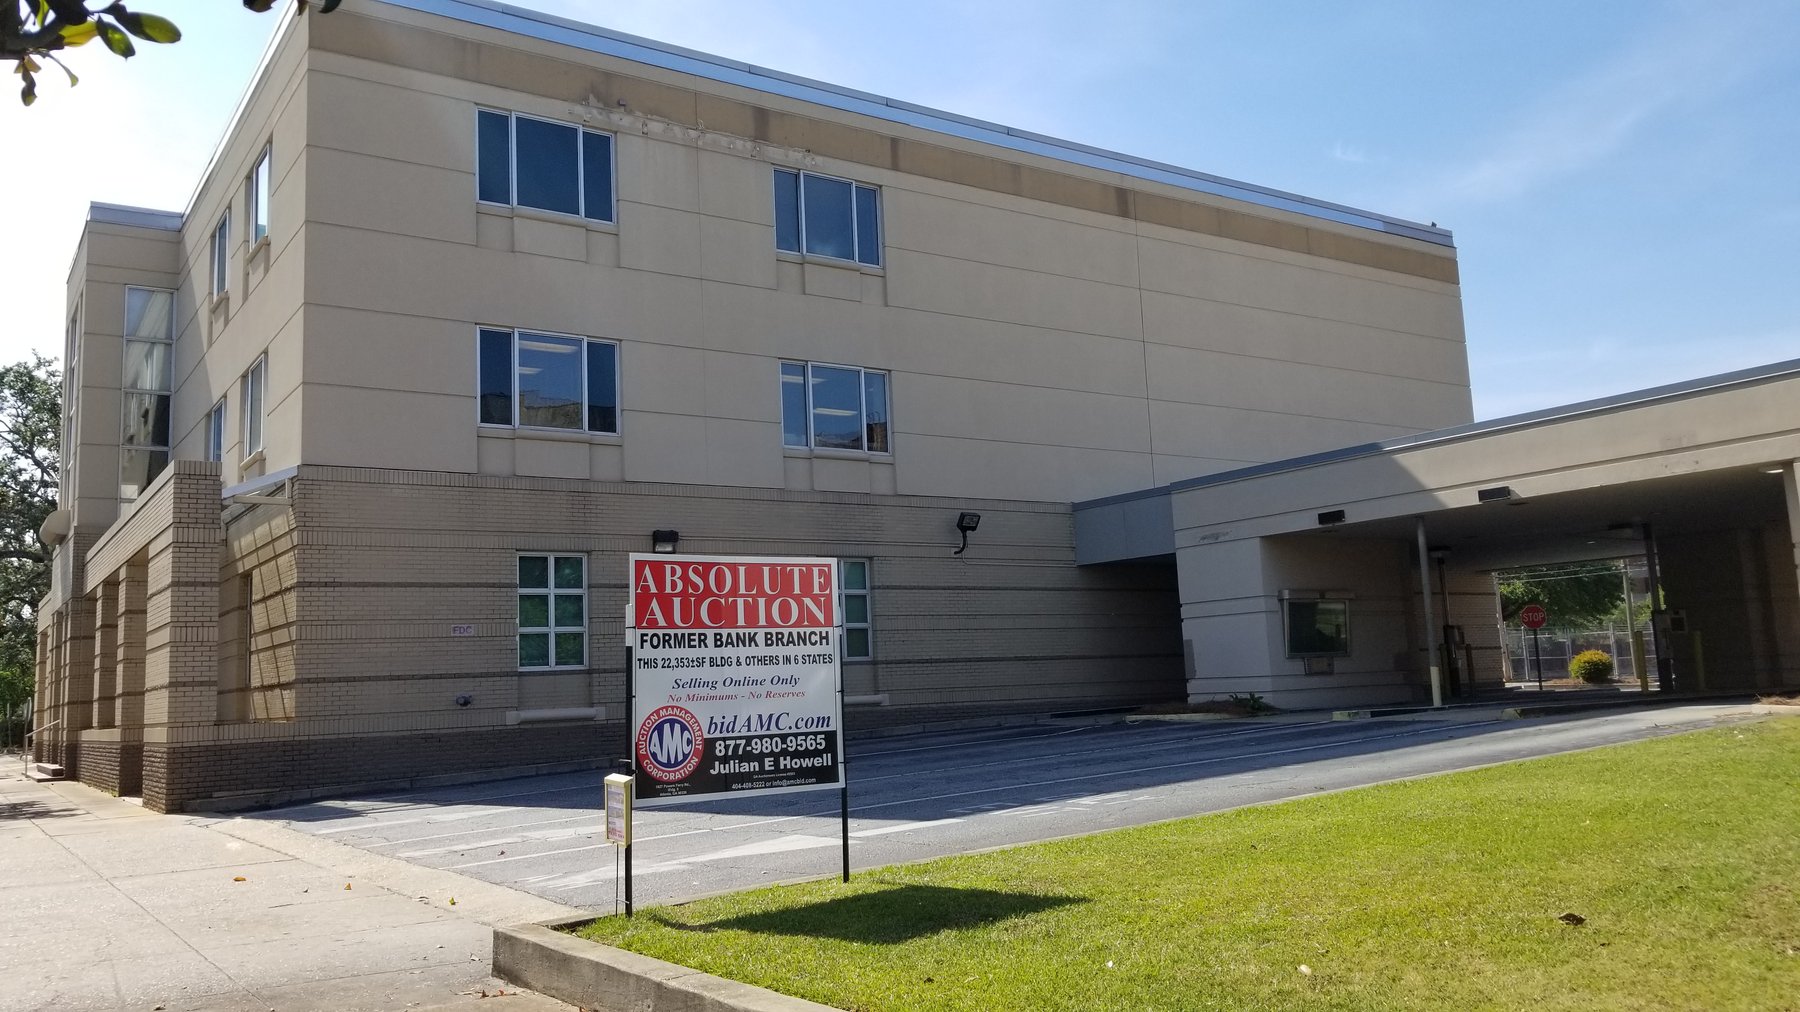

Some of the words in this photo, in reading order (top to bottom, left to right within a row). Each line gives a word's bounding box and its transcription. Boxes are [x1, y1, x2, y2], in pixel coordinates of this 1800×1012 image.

[636, 563, 831, 595] ABSOLUTE
[642, 596, 827, 627] AUCTION
[1523, 612, 1544, 622] STOP
[639, 632, 709, 650] FORMER
[713, 631, 759, 648] BANK
[764, 630, 830, 647] BRANCH
[637, 657, 659, 669] THIS
[709, 655, 733, 668] BLDG
[735, 655, 742, 667] &
[744, 654, 780, 666] OTHERS
[782, 654, 792, 666] IN
[794, 654, 800, 665] 6
[801, 653, 833, 665] STATES
[672, 677, 719, 691] Selling
[722, 676, 767, 688] Online
[770, 674, 801, 687] Only
[667, 693, 682, 703] No
[684, 692, 739, 703] Minimums
[748, 690, 762, 700] No
[765, 689, 806, 699] Reserves
[639, 712, 659, 755] AUCTION
[659, 707, 703, 750] MANAGEMENT
[707, 711, 832, 735] bidAMC.com
[649, 722, 692, 764] AMC
[715, 734, 826, 757] 877-980-9565
[643, 756, 699, 780] CORPORATION
[709, 758, 759, 775] Julian
[764, 757, 775, 771] E
[779, 753, 832, 770] Howell
